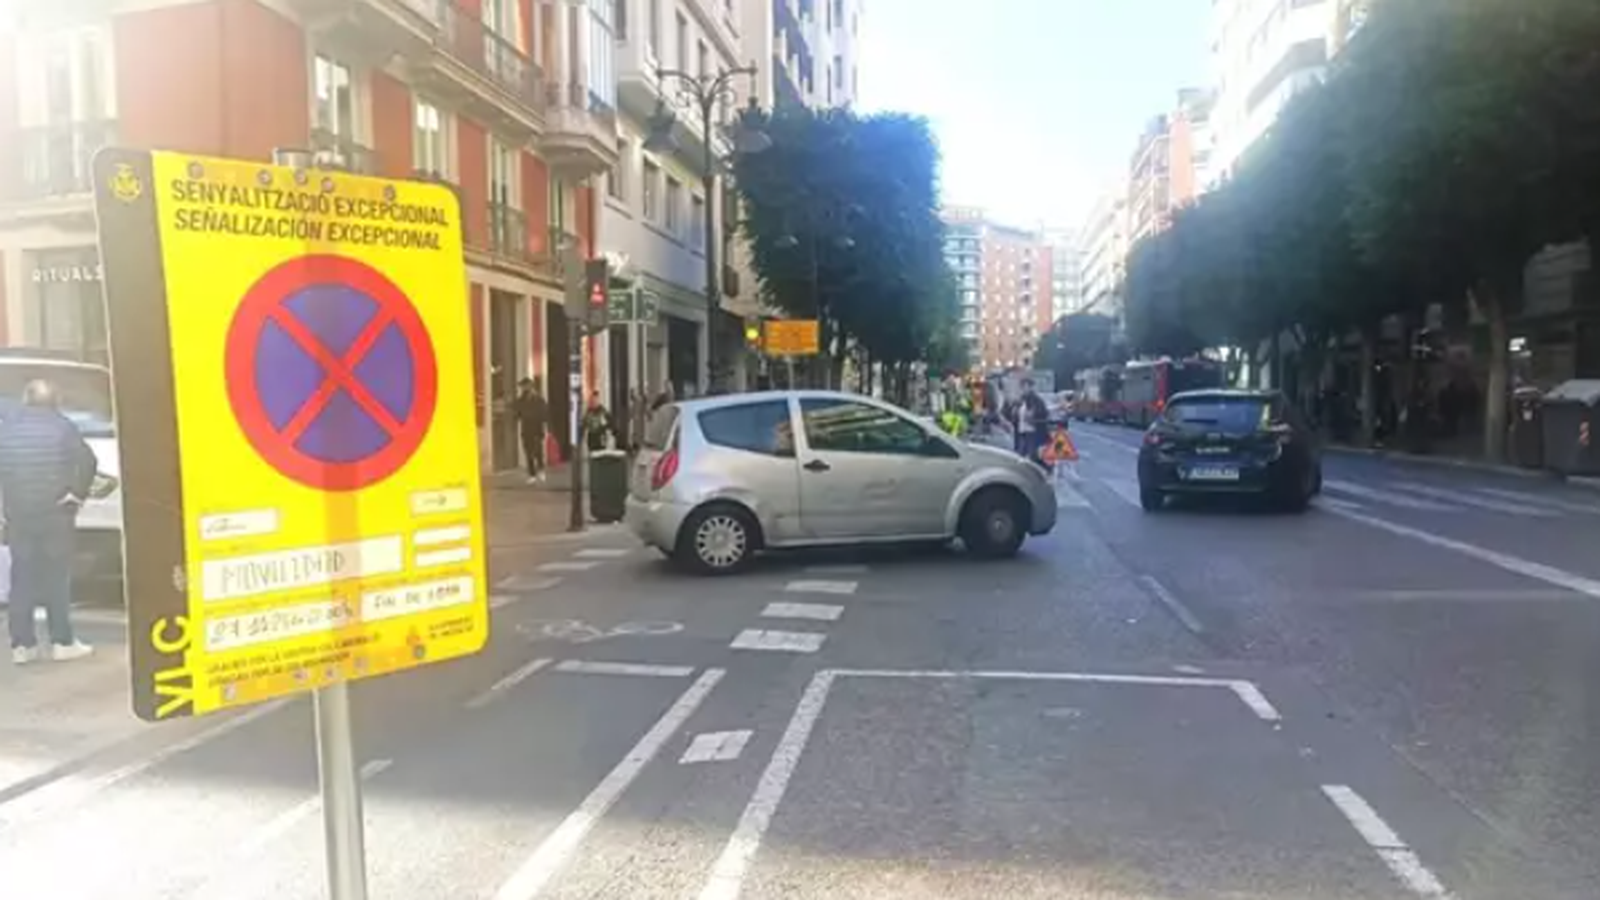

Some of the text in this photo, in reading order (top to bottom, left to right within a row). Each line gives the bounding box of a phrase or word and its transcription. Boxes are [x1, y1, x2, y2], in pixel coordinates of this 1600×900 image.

[171, 179, 449, 228] SENYALITZACIÓ EXCEPCIONAL
[327, 221, 442, 250] EXCEPCIONAL
[32, 264, 103, 282] RITUALS
